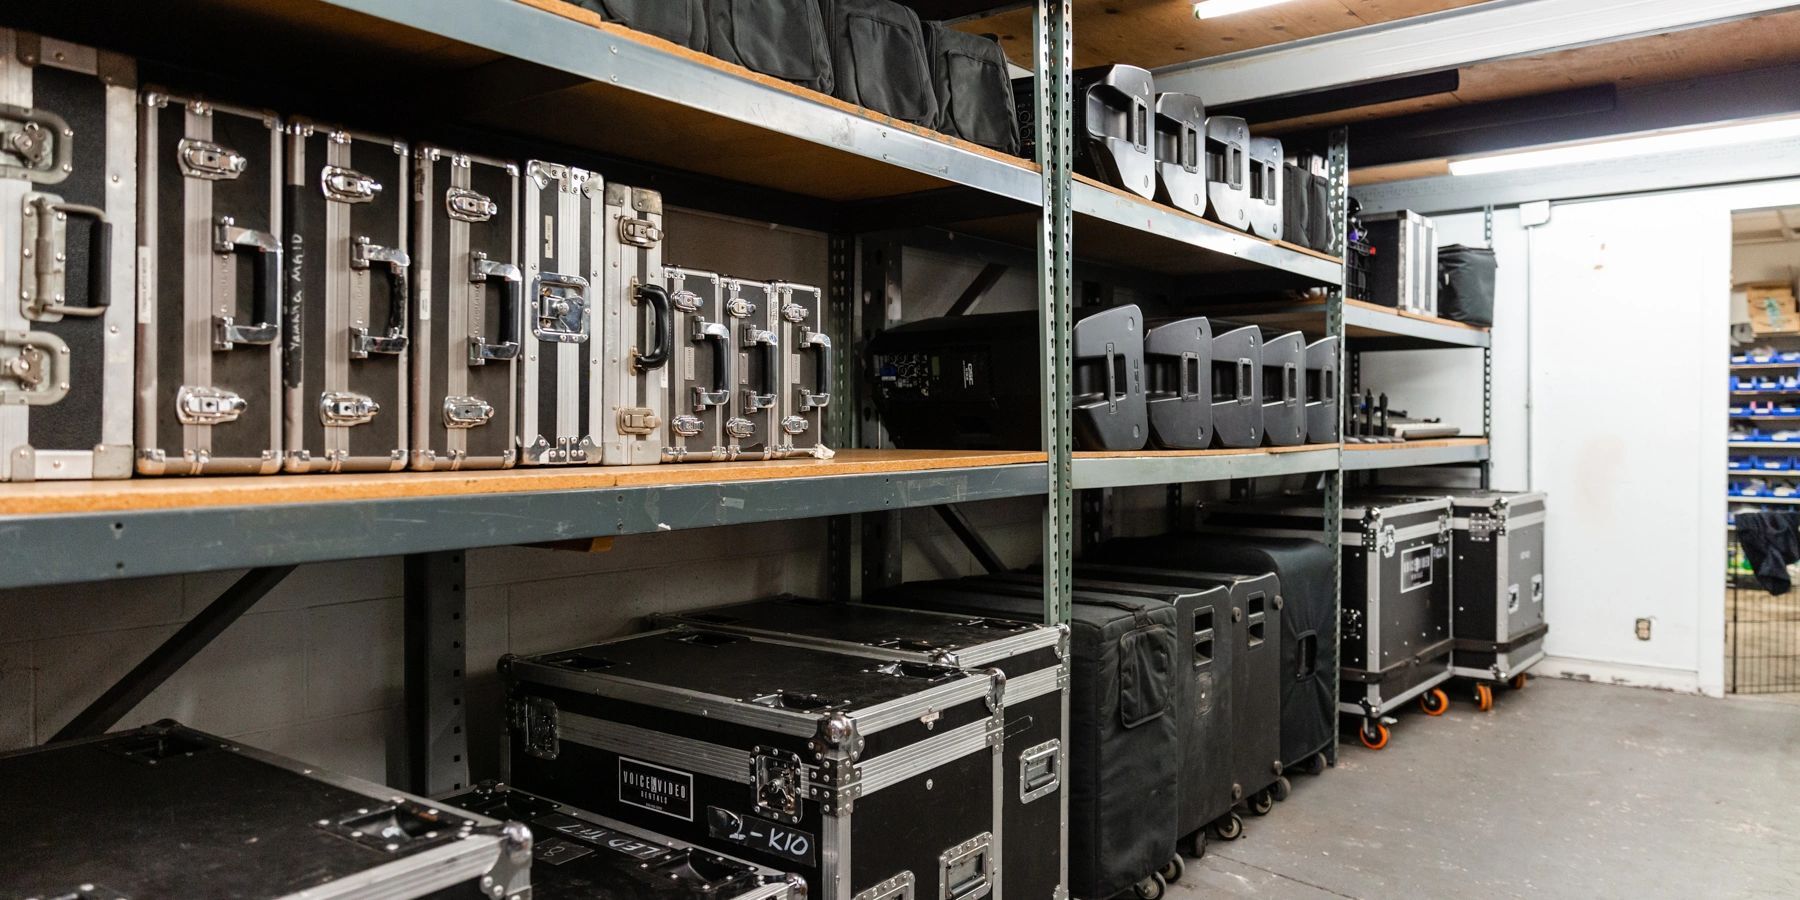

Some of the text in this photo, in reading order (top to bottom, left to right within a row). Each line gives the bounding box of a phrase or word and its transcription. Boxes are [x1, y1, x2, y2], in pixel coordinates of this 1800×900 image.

[623, 770, 650, 789] VOICE
[657, 779, 686, 799] VIDEO
[640, 790, 668, 804] RENTALS
[608, 839, 661, 856] LED
